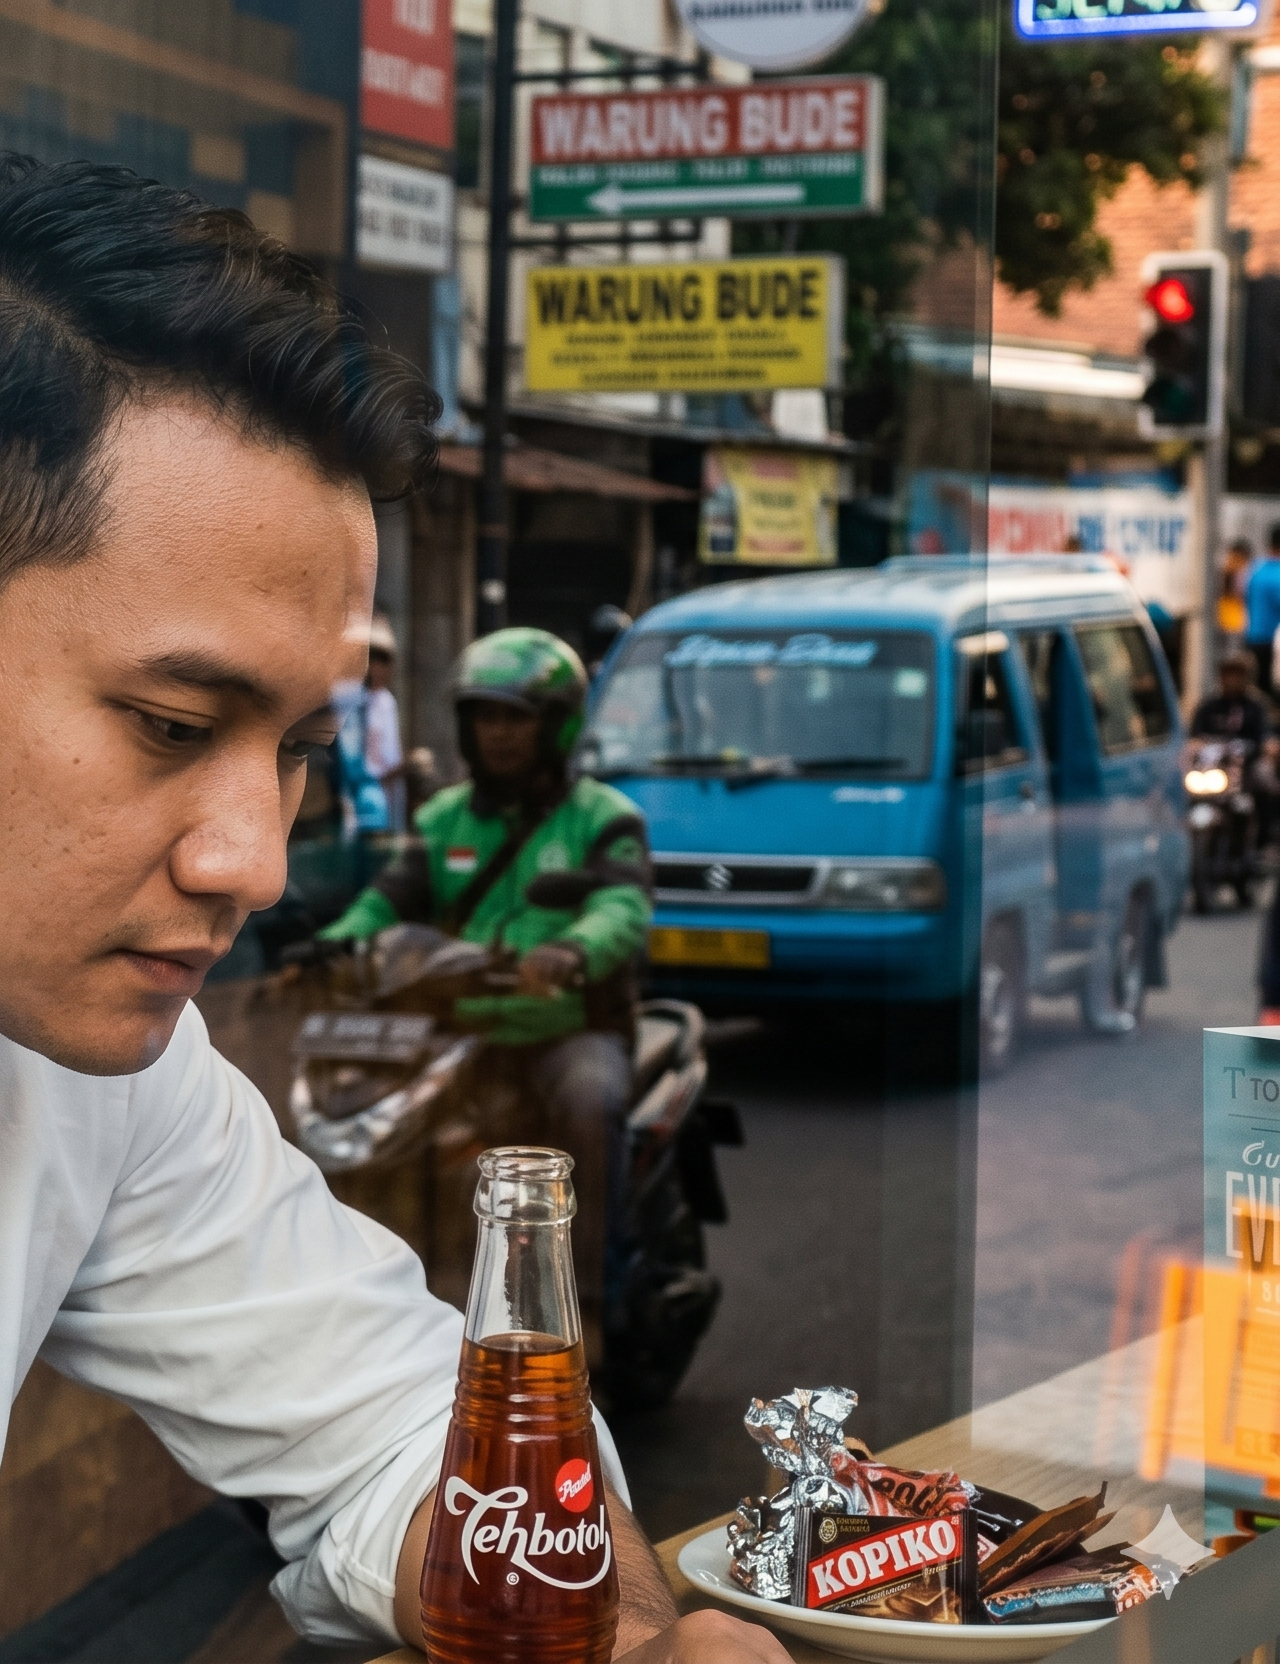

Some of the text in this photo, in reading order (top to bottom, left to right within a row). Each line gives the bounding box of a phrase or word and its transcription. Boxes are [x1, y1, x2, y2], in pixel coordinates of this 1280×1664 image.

[540, 90, 858, 156] WARUNG BUDE
[535, 269, 819, 325] WARUNG BUDE
[445, 1475, 612, 1590] Tehbotol
[811, 1519, 957, 1599] KOPIKO
